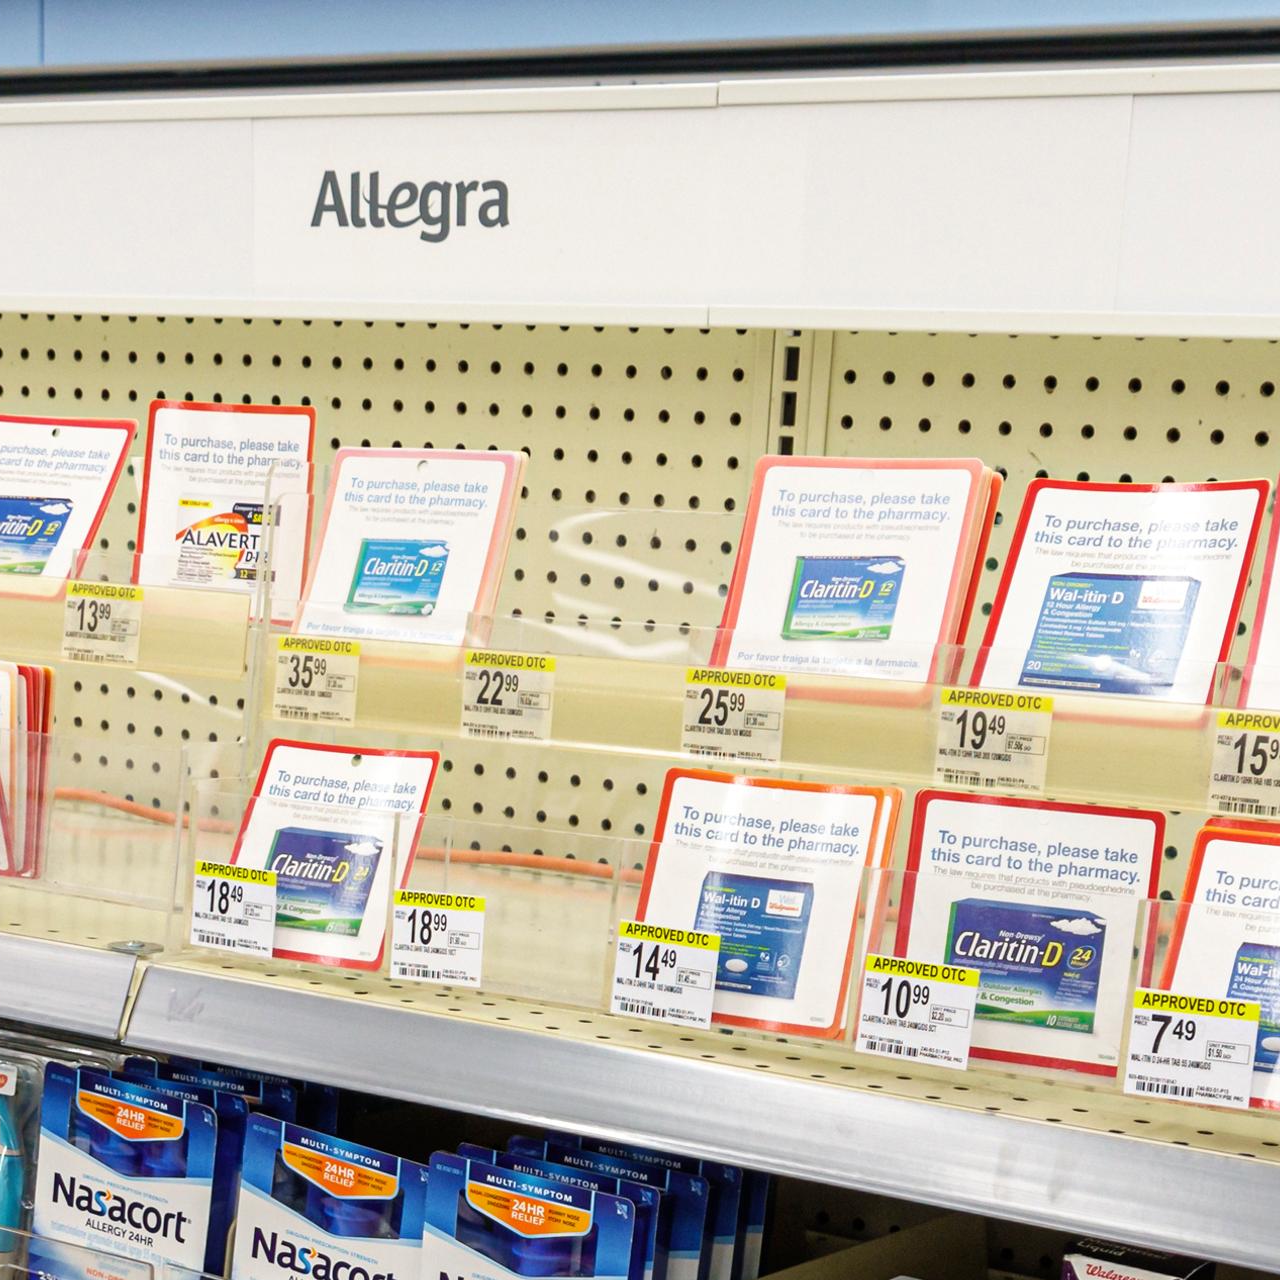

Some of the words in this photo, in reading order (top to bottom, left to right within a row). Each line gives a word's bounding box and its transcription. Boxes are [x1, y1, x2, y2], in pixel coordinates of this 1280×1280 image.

[311, 170, 510, 245] Allegra
[182, 526, 259, 552] ALAVERT
[284, 637, 330, 650] APPROVED
[332, 641, 352, 653] OTC
[94, 1084, 168, 1110] MULTI-SYMPTOM
[52, 1172, 187, 1243] Nasacort
[85, 1218, 126, 1240] ALLERGY
[128, 1231, 153, 1247] 24HR
